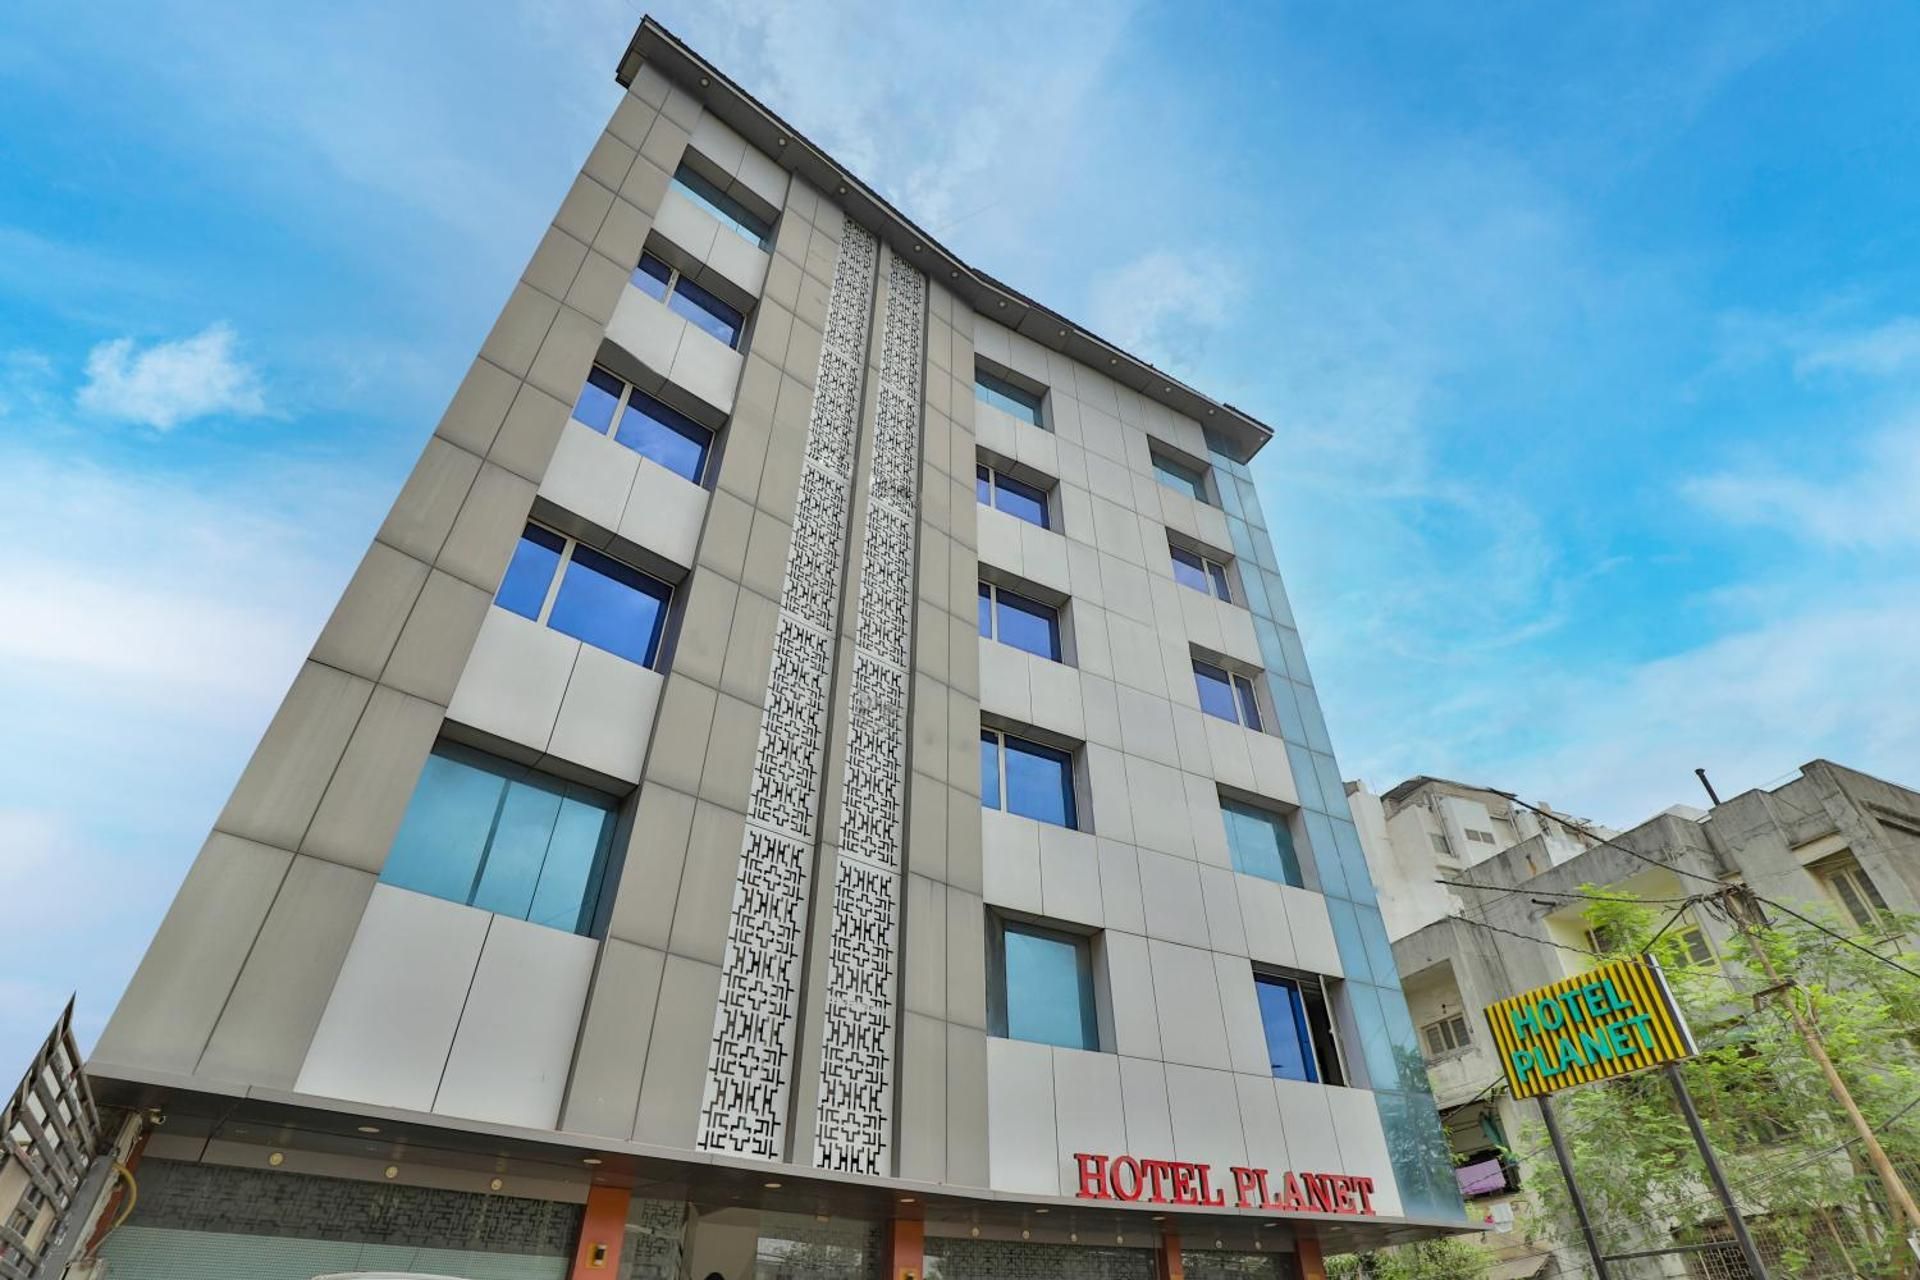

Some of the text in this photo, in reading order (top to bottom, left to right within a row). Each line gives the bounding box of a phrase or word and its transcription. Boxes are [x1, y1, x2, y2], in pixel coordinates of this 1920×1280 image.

[1511, 978, 1633, 1041] HOTEL
[1511, 1013, 1655, 1083] PLANET
[1073, 1152, 1376, 1216] HOTEL PLANET
